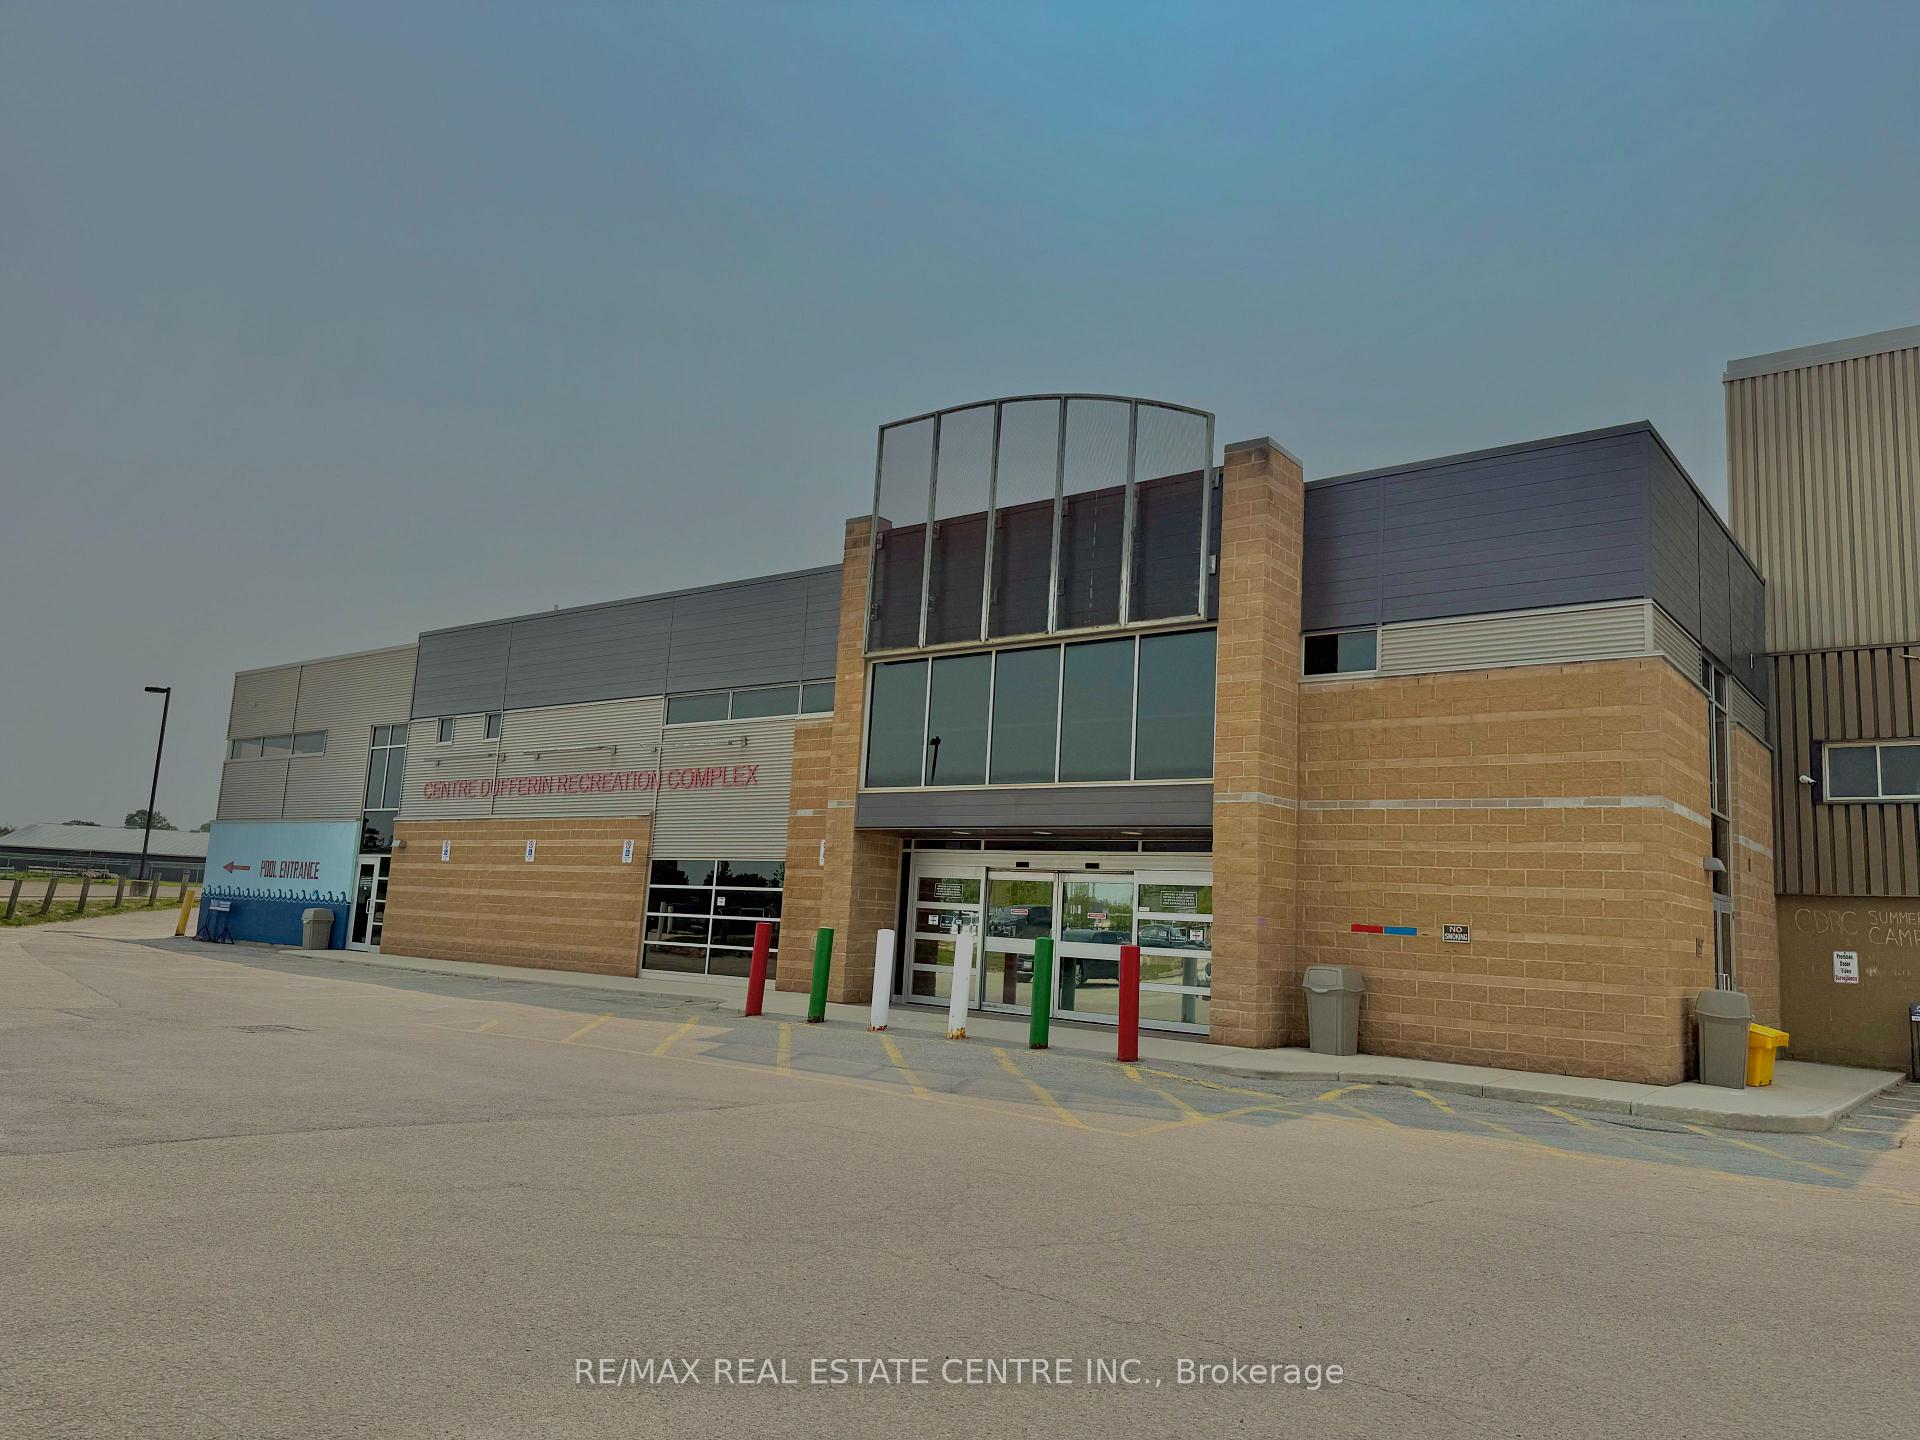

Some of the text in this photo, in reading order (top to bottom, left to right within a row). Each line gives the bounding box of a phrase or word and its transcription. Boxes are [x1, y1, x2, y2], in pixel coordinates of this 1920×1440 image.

[425, 764, 759, 799] CENTRE DUFFERIN RECREATION COMPLEX
[260, 860, 320, 879] POOL ENTRANCE
[1795, 908, 1858, 935] CDRC
